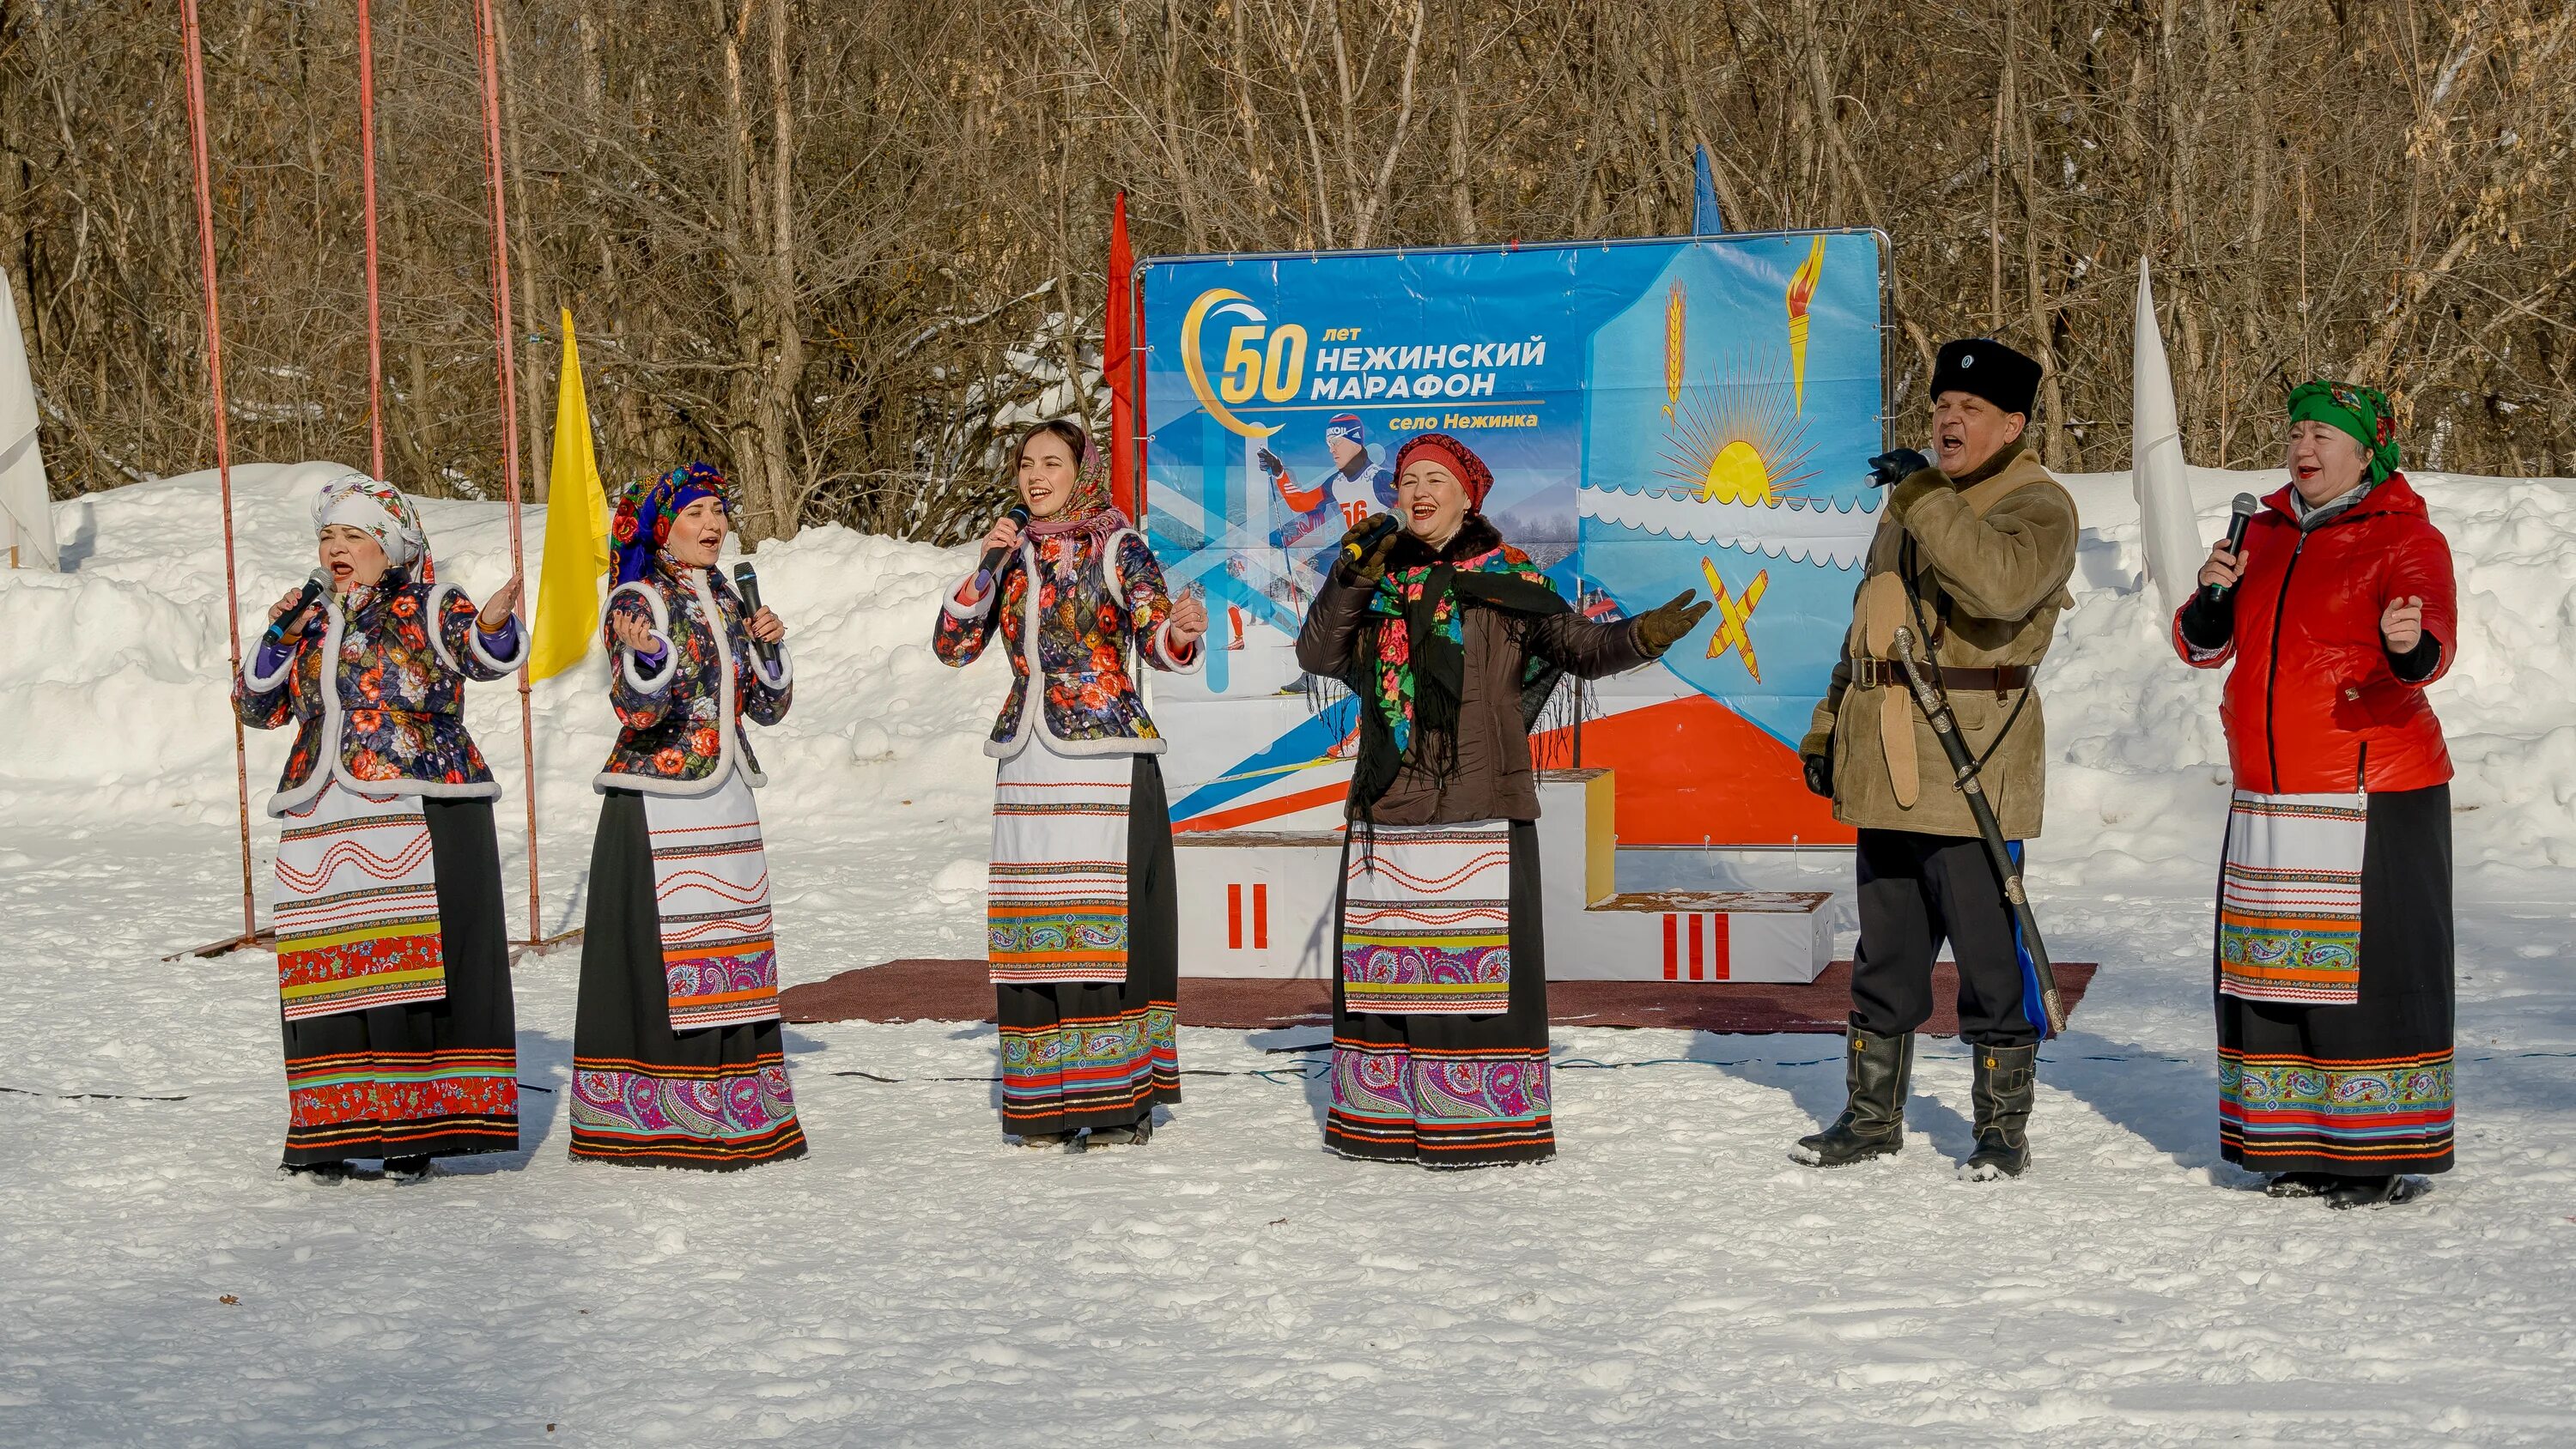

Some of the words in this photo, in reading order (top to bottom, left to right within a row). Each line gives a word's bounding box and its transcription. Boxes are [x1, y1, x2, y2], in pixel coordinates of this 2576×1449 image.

[1322, 326, 1362, 343] лет
[1220, 323, 1308, 404] 50
[1315, 335, 1546, 372] НЕЖИНСКИЙ
[1310, 373, 1496, 401] МАРАФОН
[1389, 415, 1438, 431] село
[1443, 413, 1539, 429] Нежинка
[1340, 500, 1368, 530] 56
